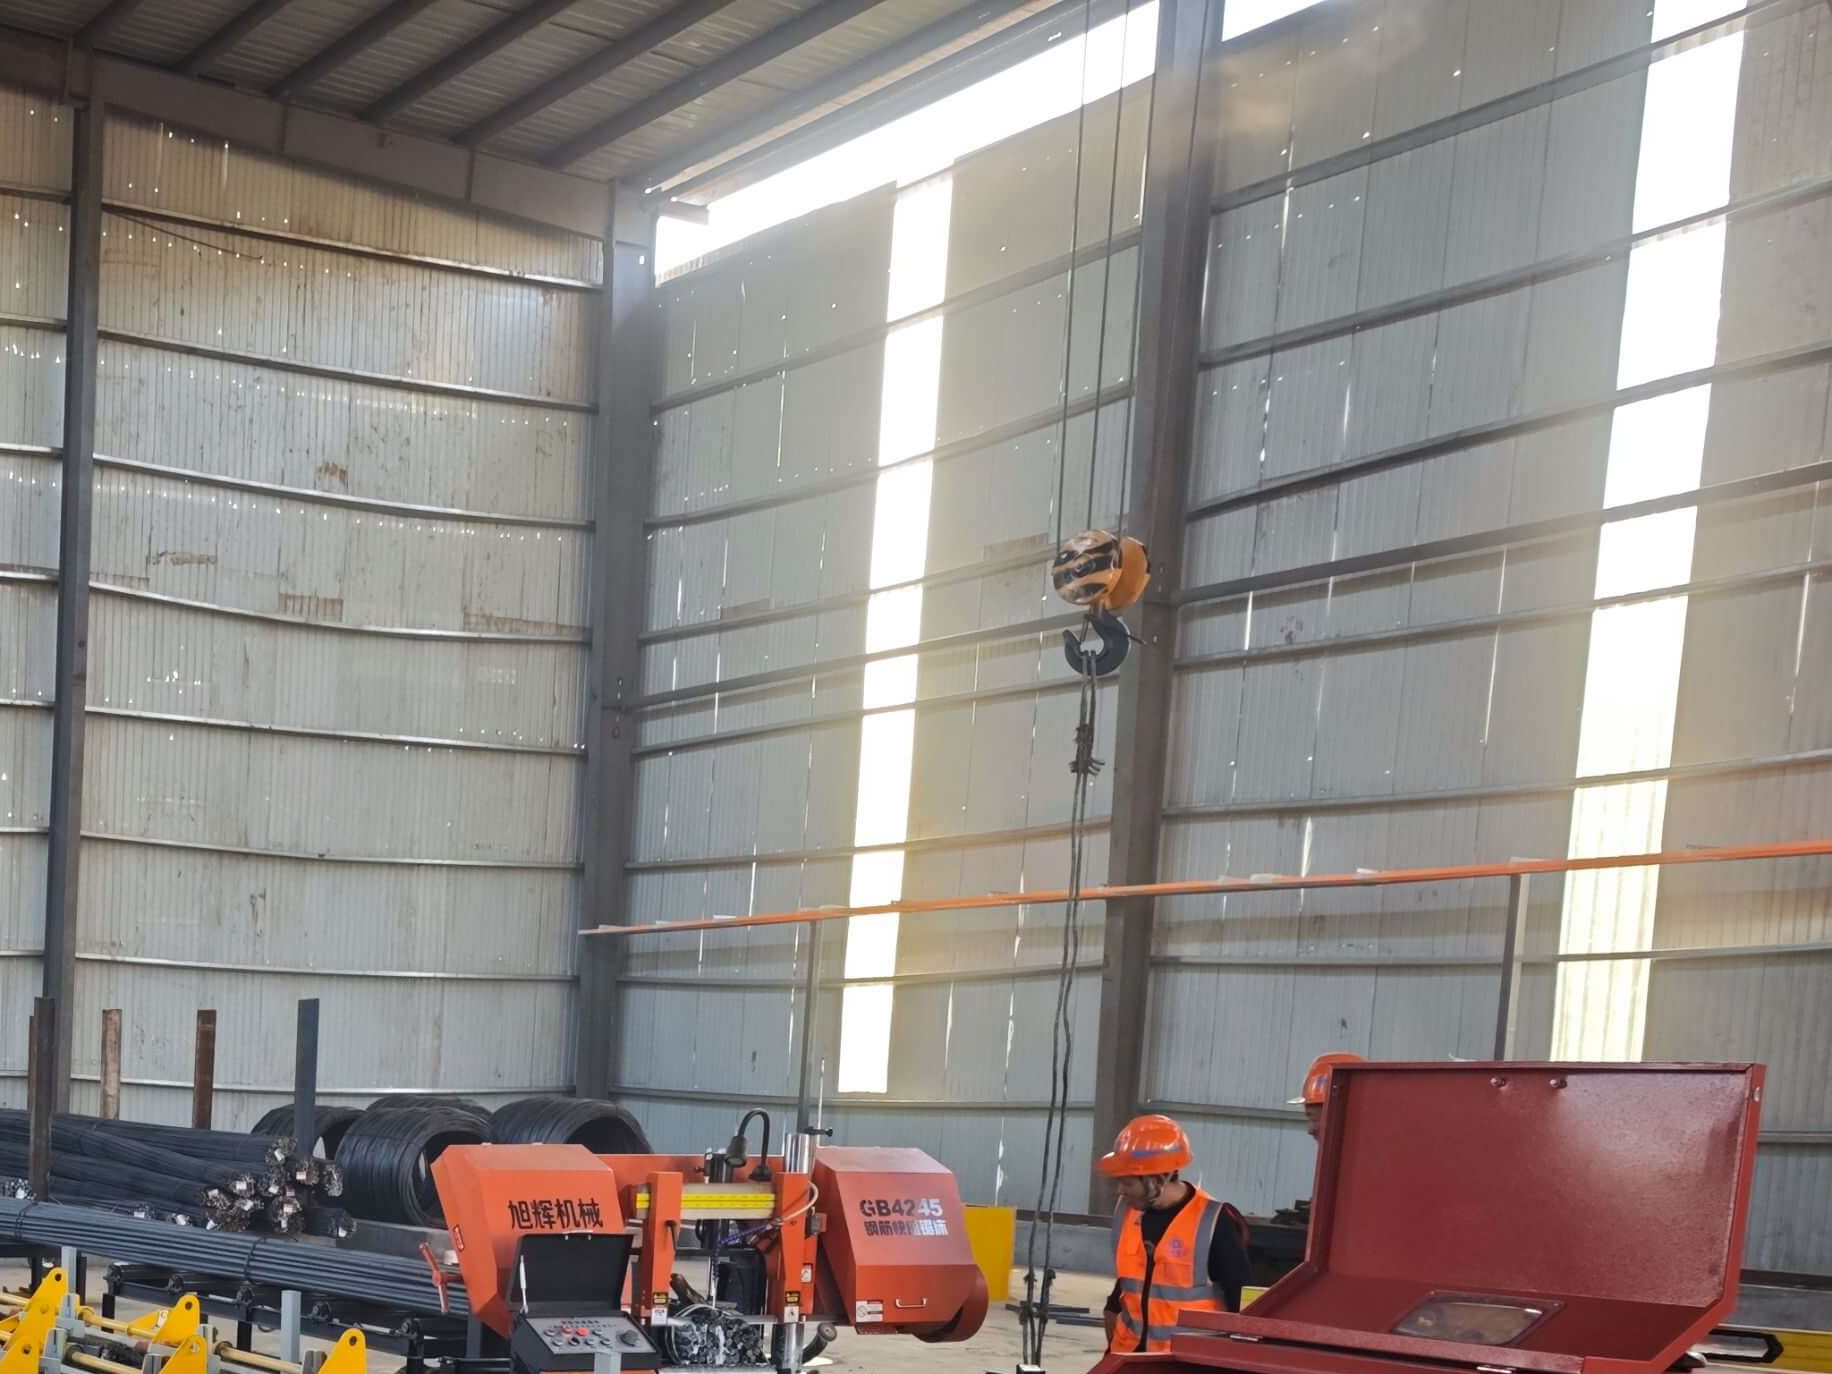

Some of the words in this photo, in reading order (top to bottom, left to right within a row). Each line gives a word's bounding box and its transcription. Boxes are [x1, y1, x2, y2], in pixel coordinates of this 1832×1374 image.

[508, 1198, 603, 1229] 旭辉机械
[859, 1198, 943, 1217] GB4245
